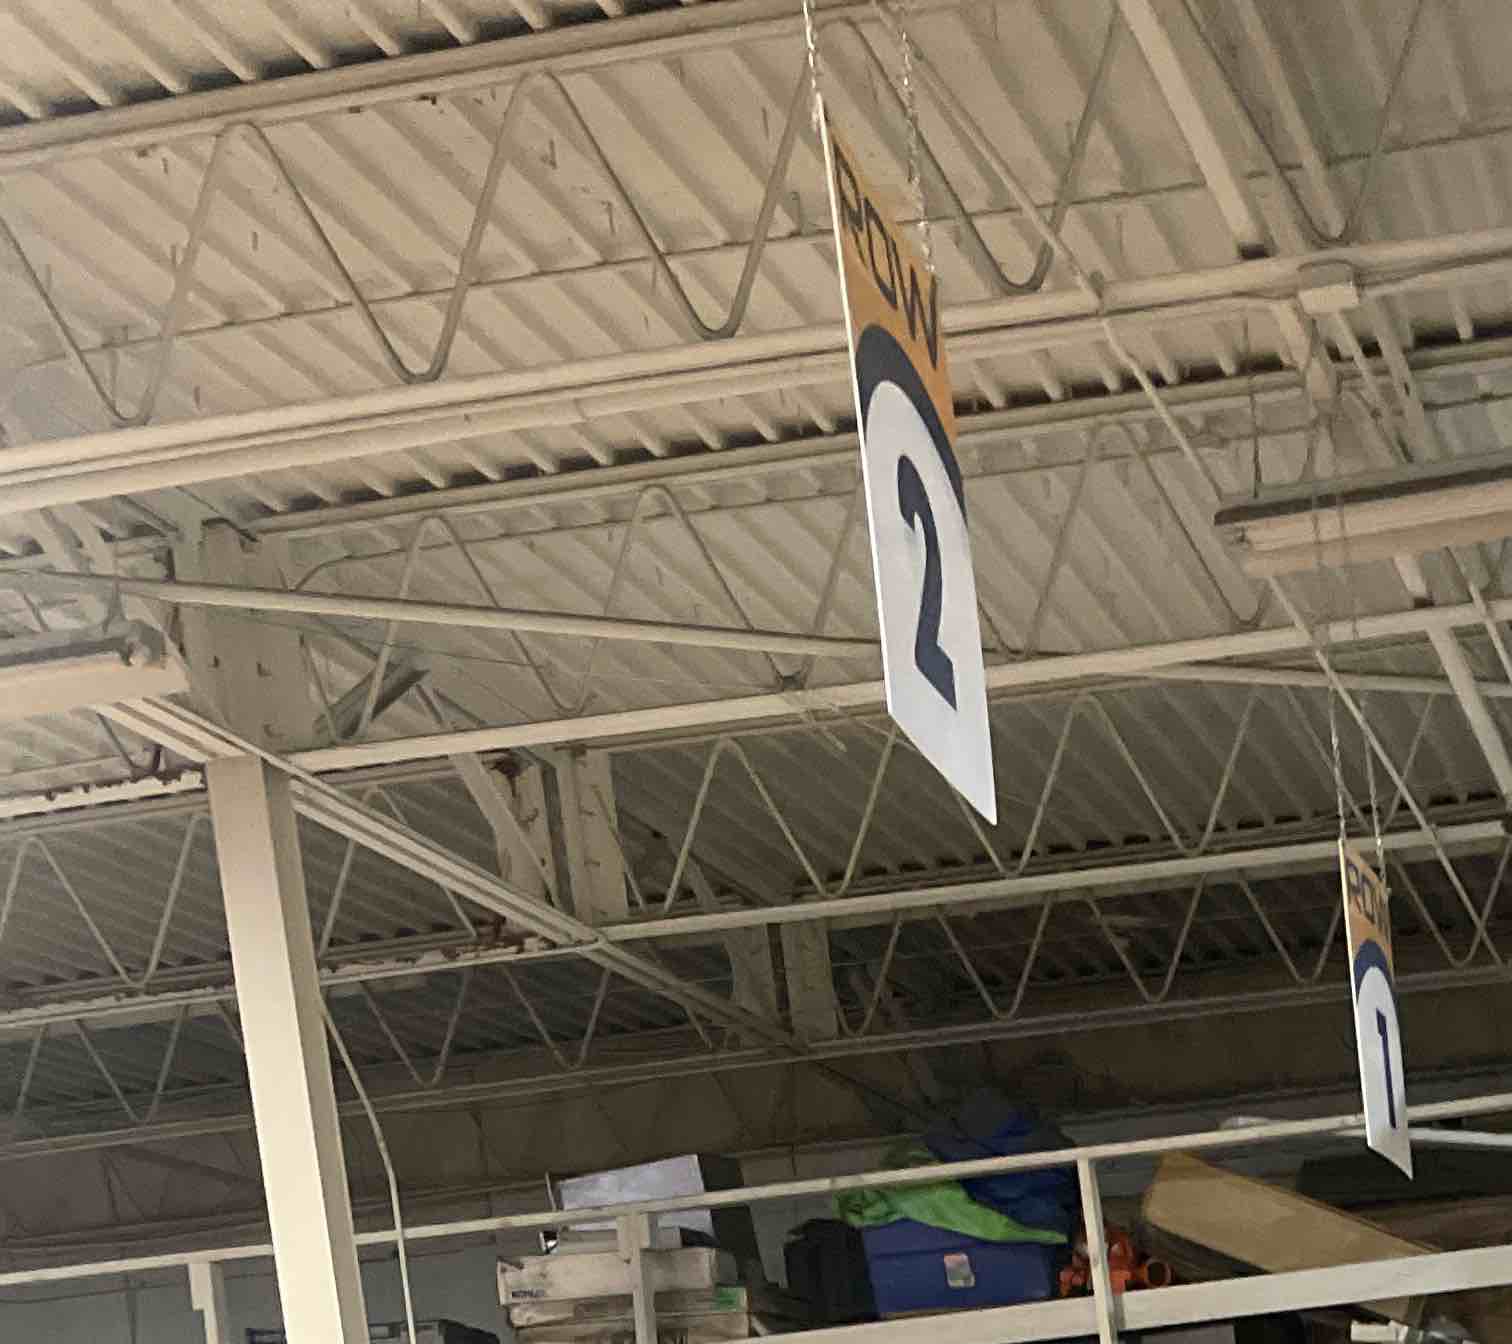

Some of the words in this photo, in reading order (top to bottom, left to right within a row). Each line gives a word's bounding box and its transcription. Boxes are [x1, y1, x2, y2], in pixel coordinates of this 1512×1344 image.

[834, 149, 939, 369] ROW
[898, 454, 958, 712] 2
[1375, 1006, 1397, 1130] 1
